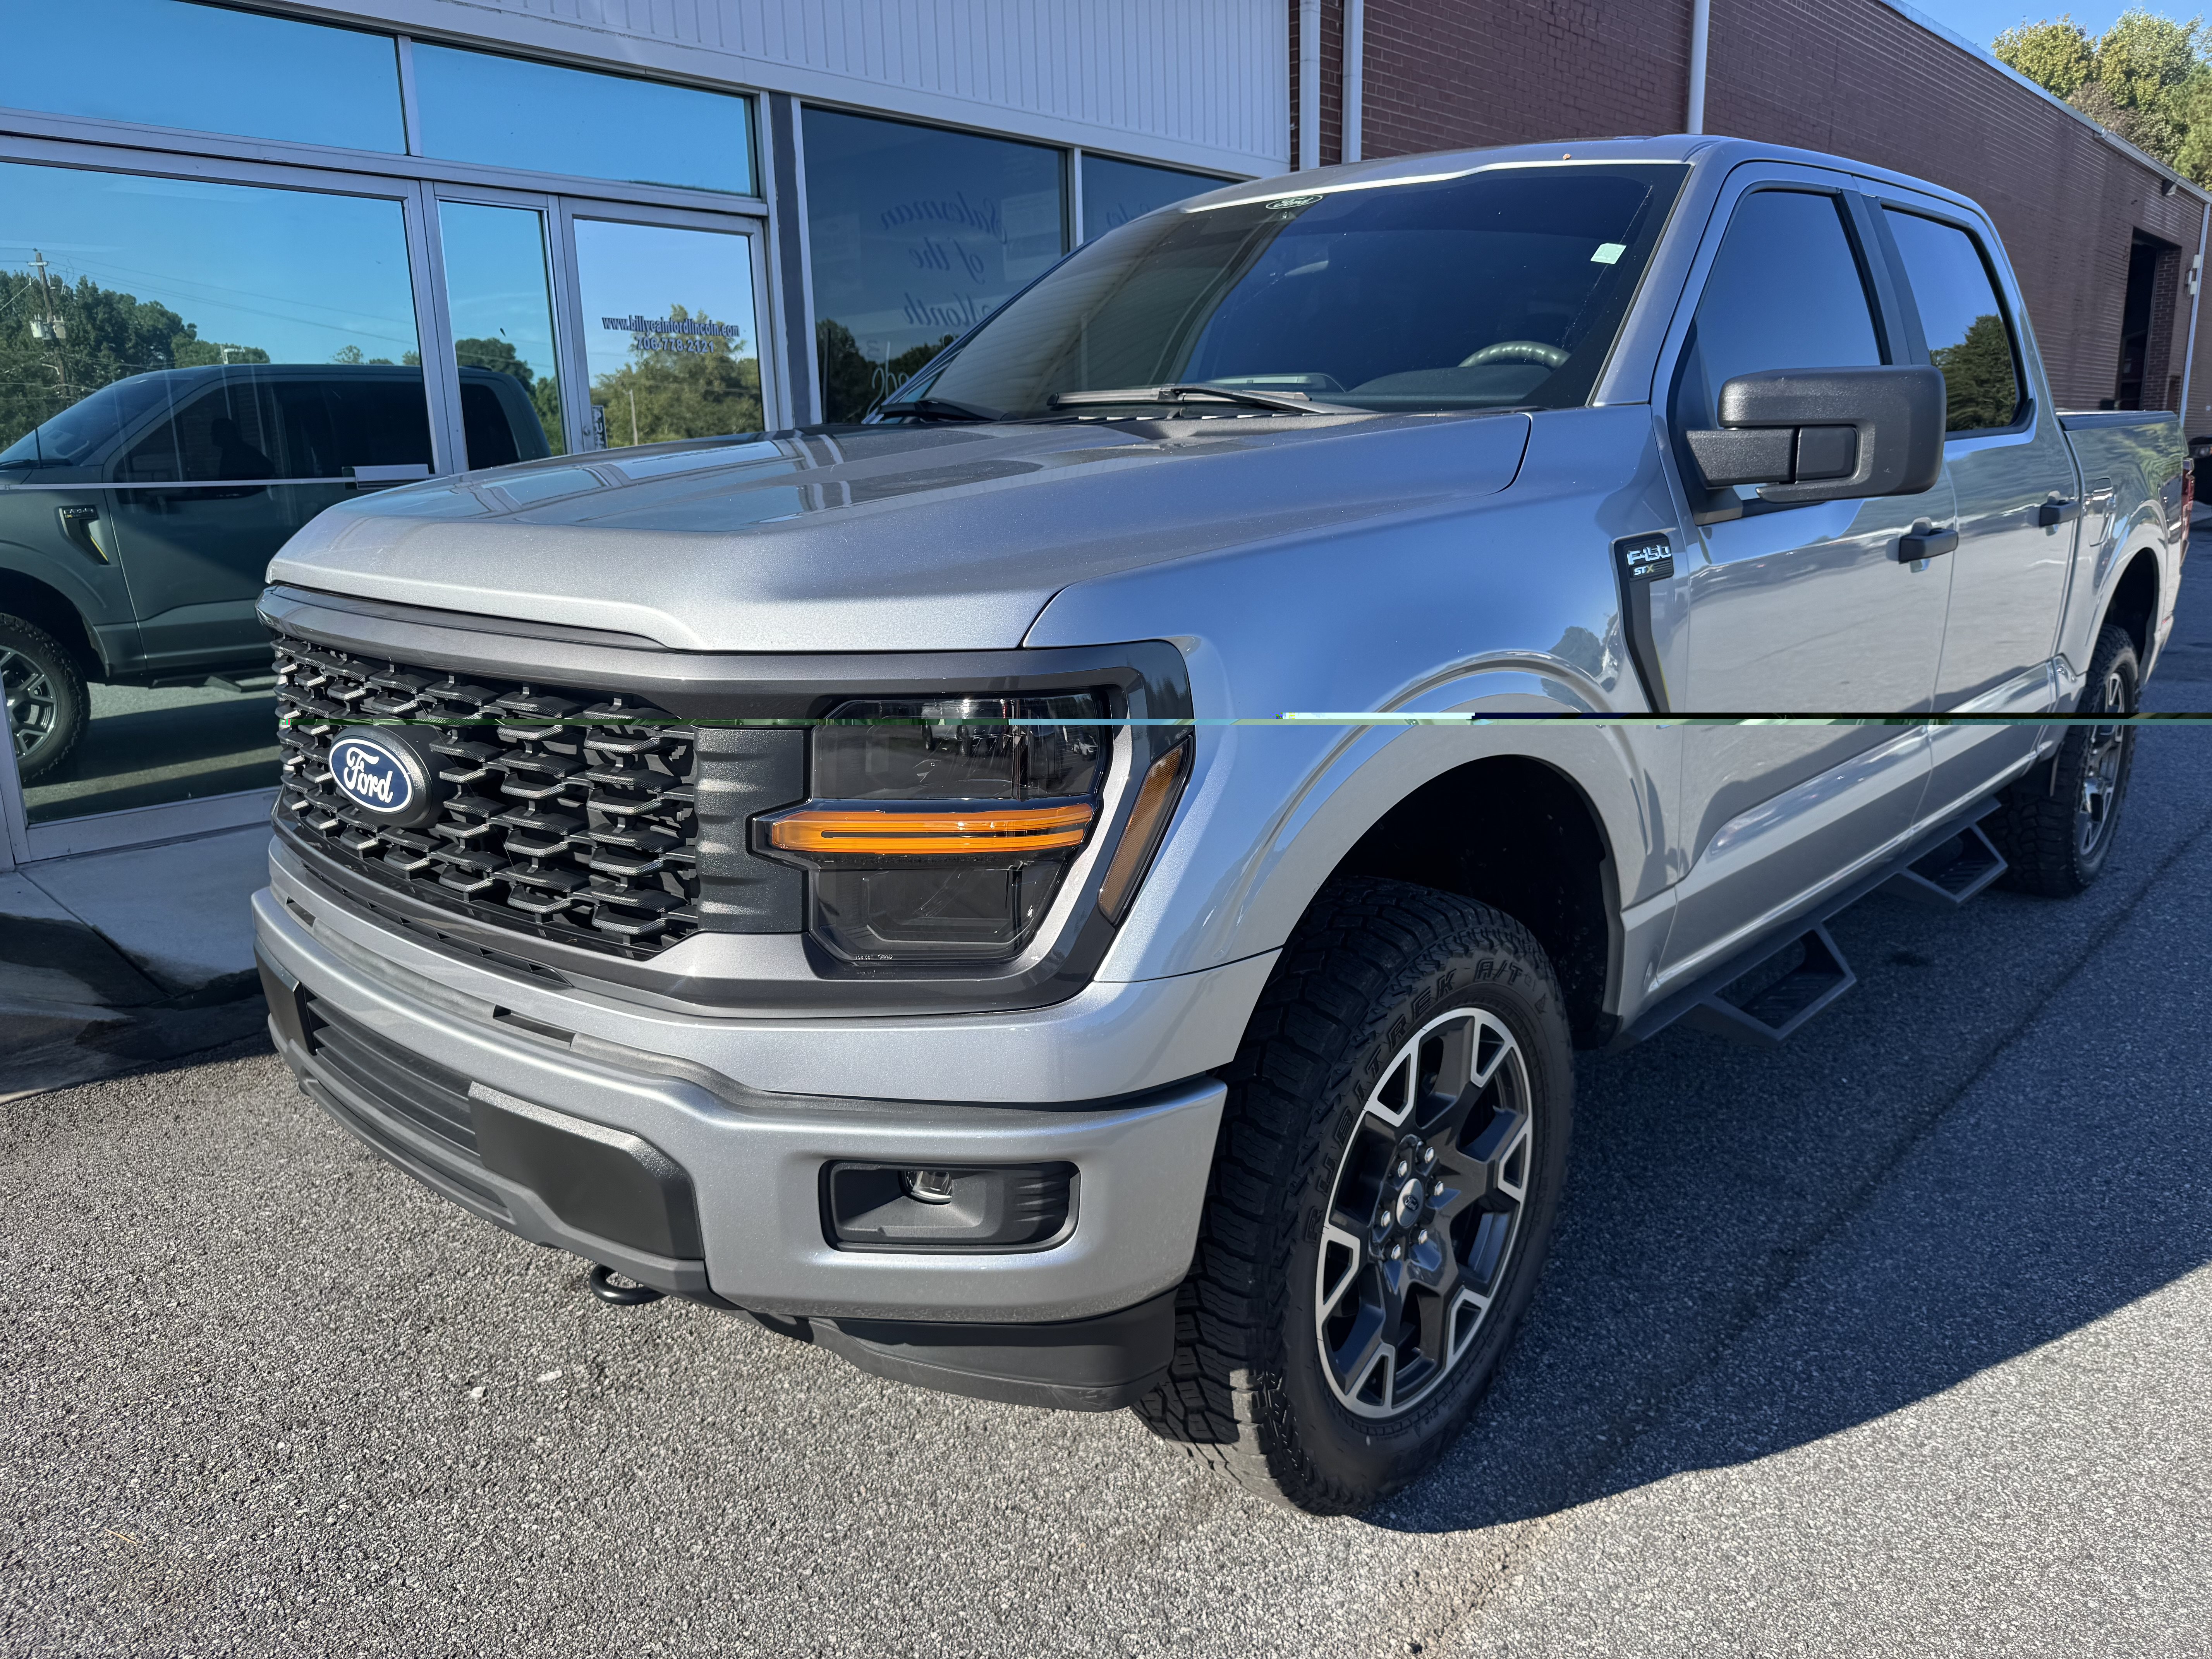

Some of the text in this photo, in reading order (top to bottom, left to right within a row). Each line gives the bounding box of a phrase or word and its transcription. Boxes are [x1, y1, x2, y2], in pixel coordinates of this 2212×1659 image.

[1273, 197, 1314, 208] Ford
[636, 337, 714, 353] 706-778-2121
[1627, 544, 1671, 565] F-150
[1634, 564, 1654, 575] STX
[343, 747, 393, 803] Ford
[1404, 1195, 1418, 1211] Ford
